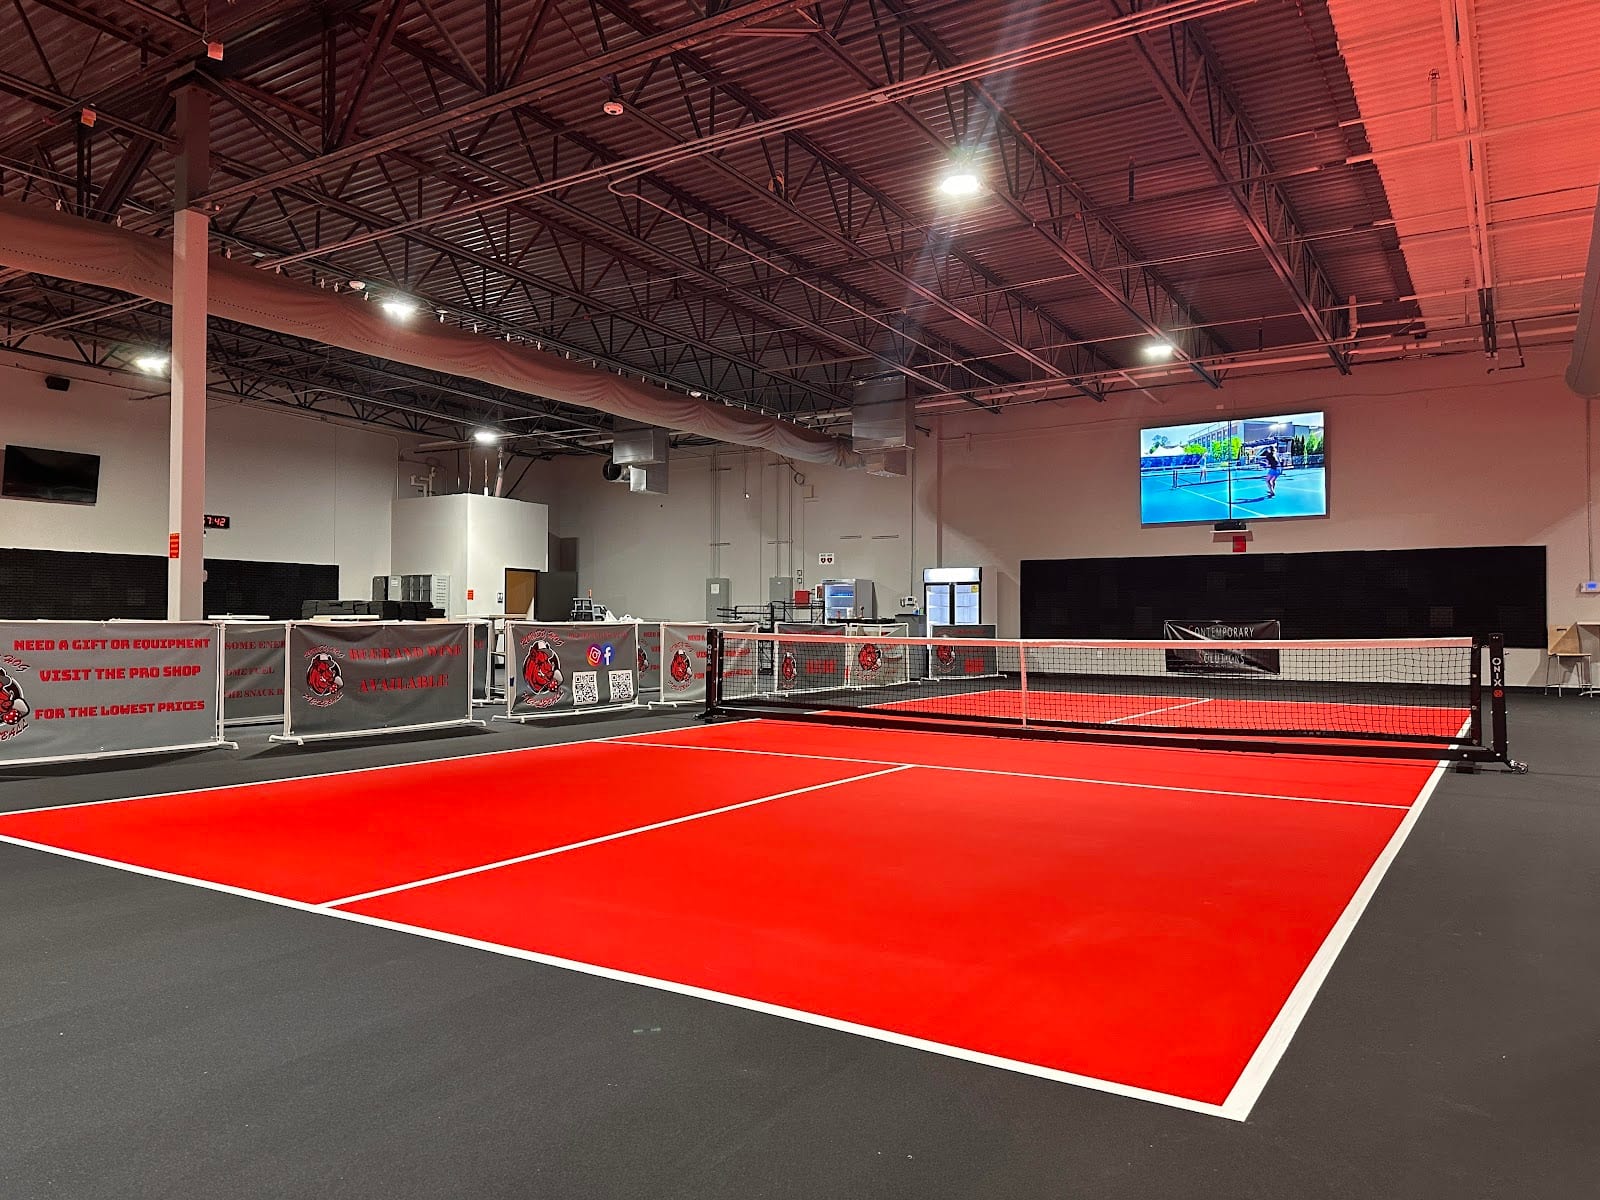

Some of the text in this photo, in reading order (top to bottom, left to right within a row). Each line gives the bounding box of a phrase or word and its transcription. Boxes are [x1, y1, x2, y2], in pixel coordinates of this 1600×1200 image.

[14, 638, 211, 651] NEED A GIFT OR EQUIPMENT
[258, 640, 286, 649] ENER
[348, 648, 391, 661] BEER
[395, 646, 424, 659] AND
[426, 644, 463, 657] WINE
[39, 665, 202, 682] VISIT THE PRO SHOP
[1491, 657, 1502, 687] ONIX
[359, 673, 450, 694] AVAILABLE
[35, 700, 205, 720] FOR THE LOWEST PRICES
